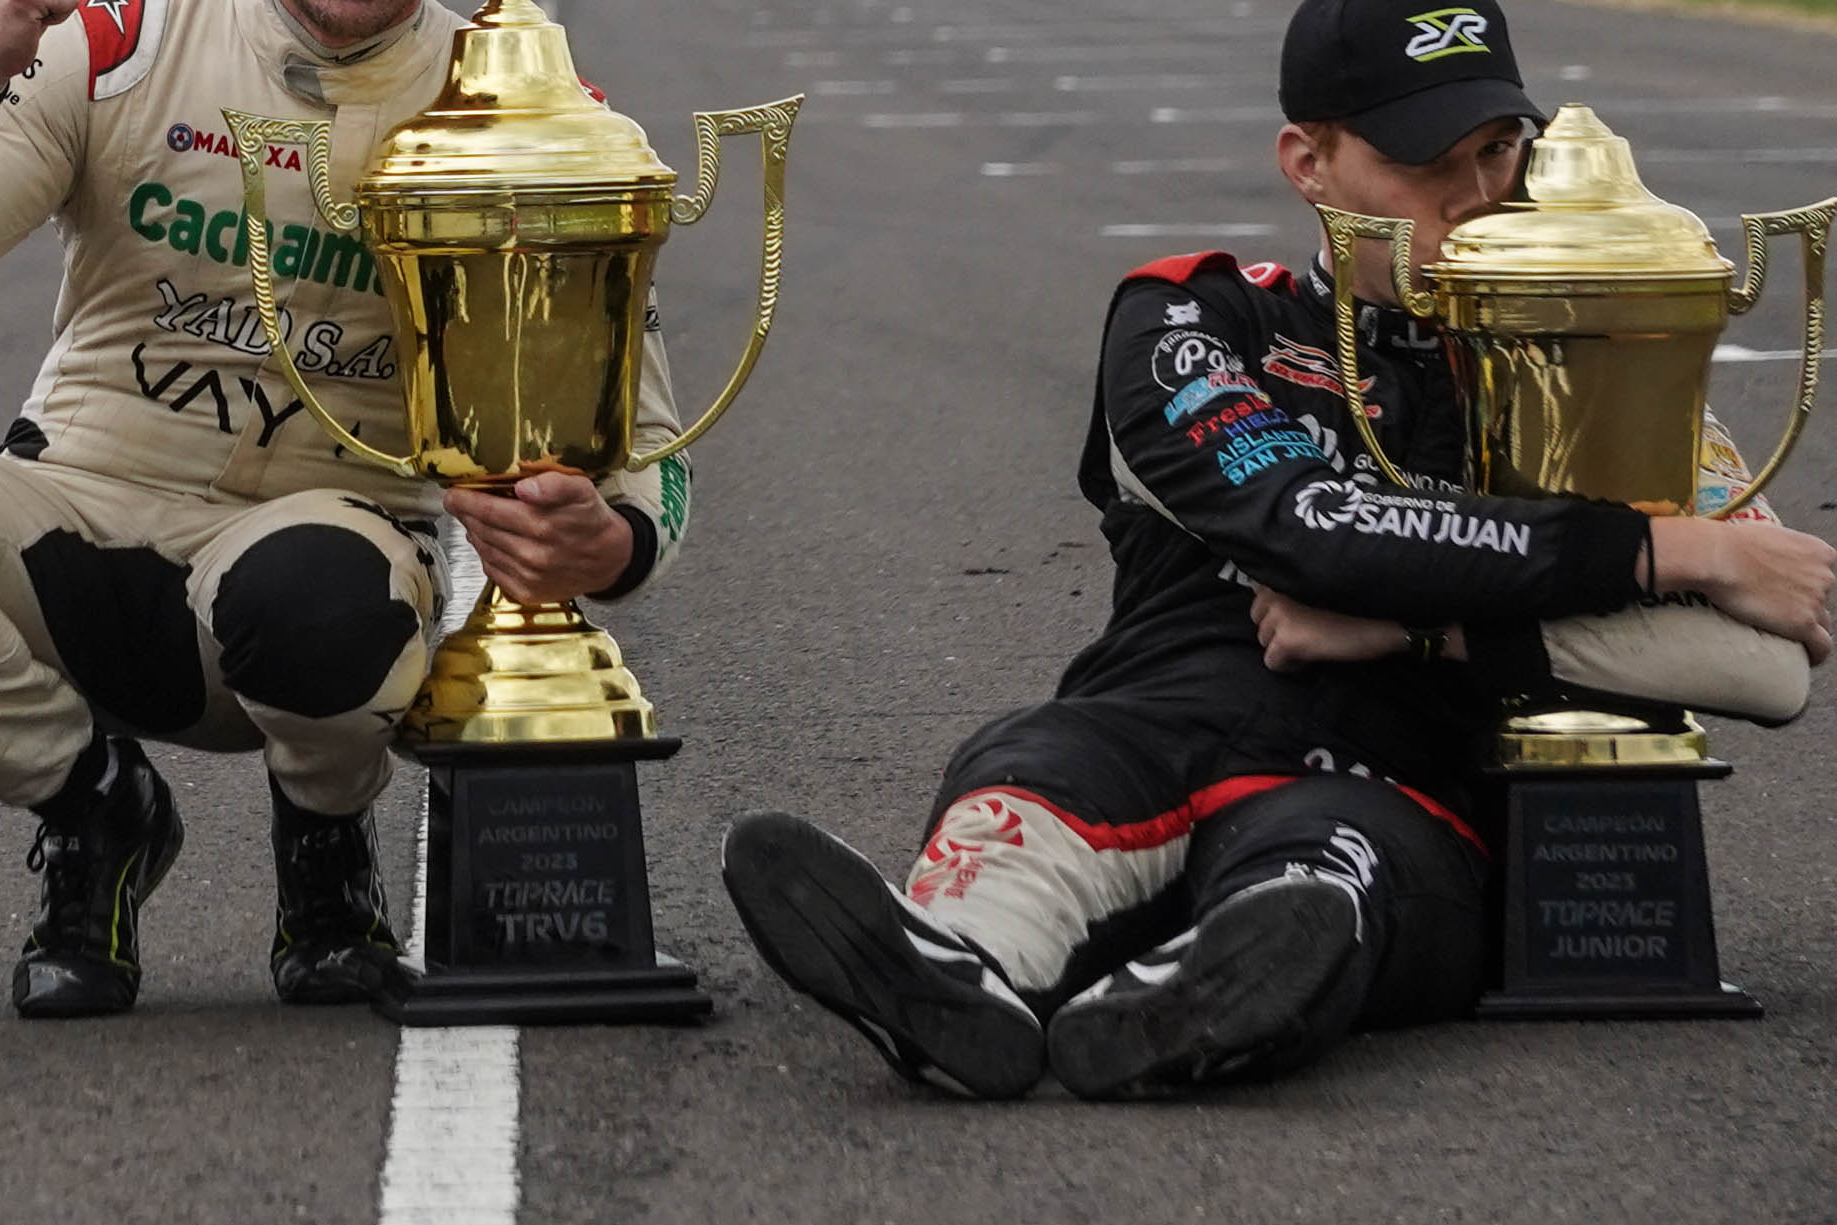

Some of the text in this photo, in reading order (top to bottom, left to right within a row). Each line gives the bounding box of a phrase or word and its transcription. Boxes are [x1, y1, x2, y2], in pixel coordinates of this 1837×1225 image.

[128, 181, 385, 298] Cacham
[153, 278, 396, 380] YAD S.A.
[1227, 448, 1280, 486] SAN
[1353, 503, 1531, 557] SAN JUAN
[478, 823, 619, 846] ARGENTINO
[520, 852, 580, 871] 2023
[1533, 843, 1679, 864] ARGENTINO
[485, 879, 618, 909] TOPRACE
[496, 911, 609, 944] TRV6
[1537, 899, 1677, 928] TOPRACE
[1547, 935, 1669, 960] JUNIOR
